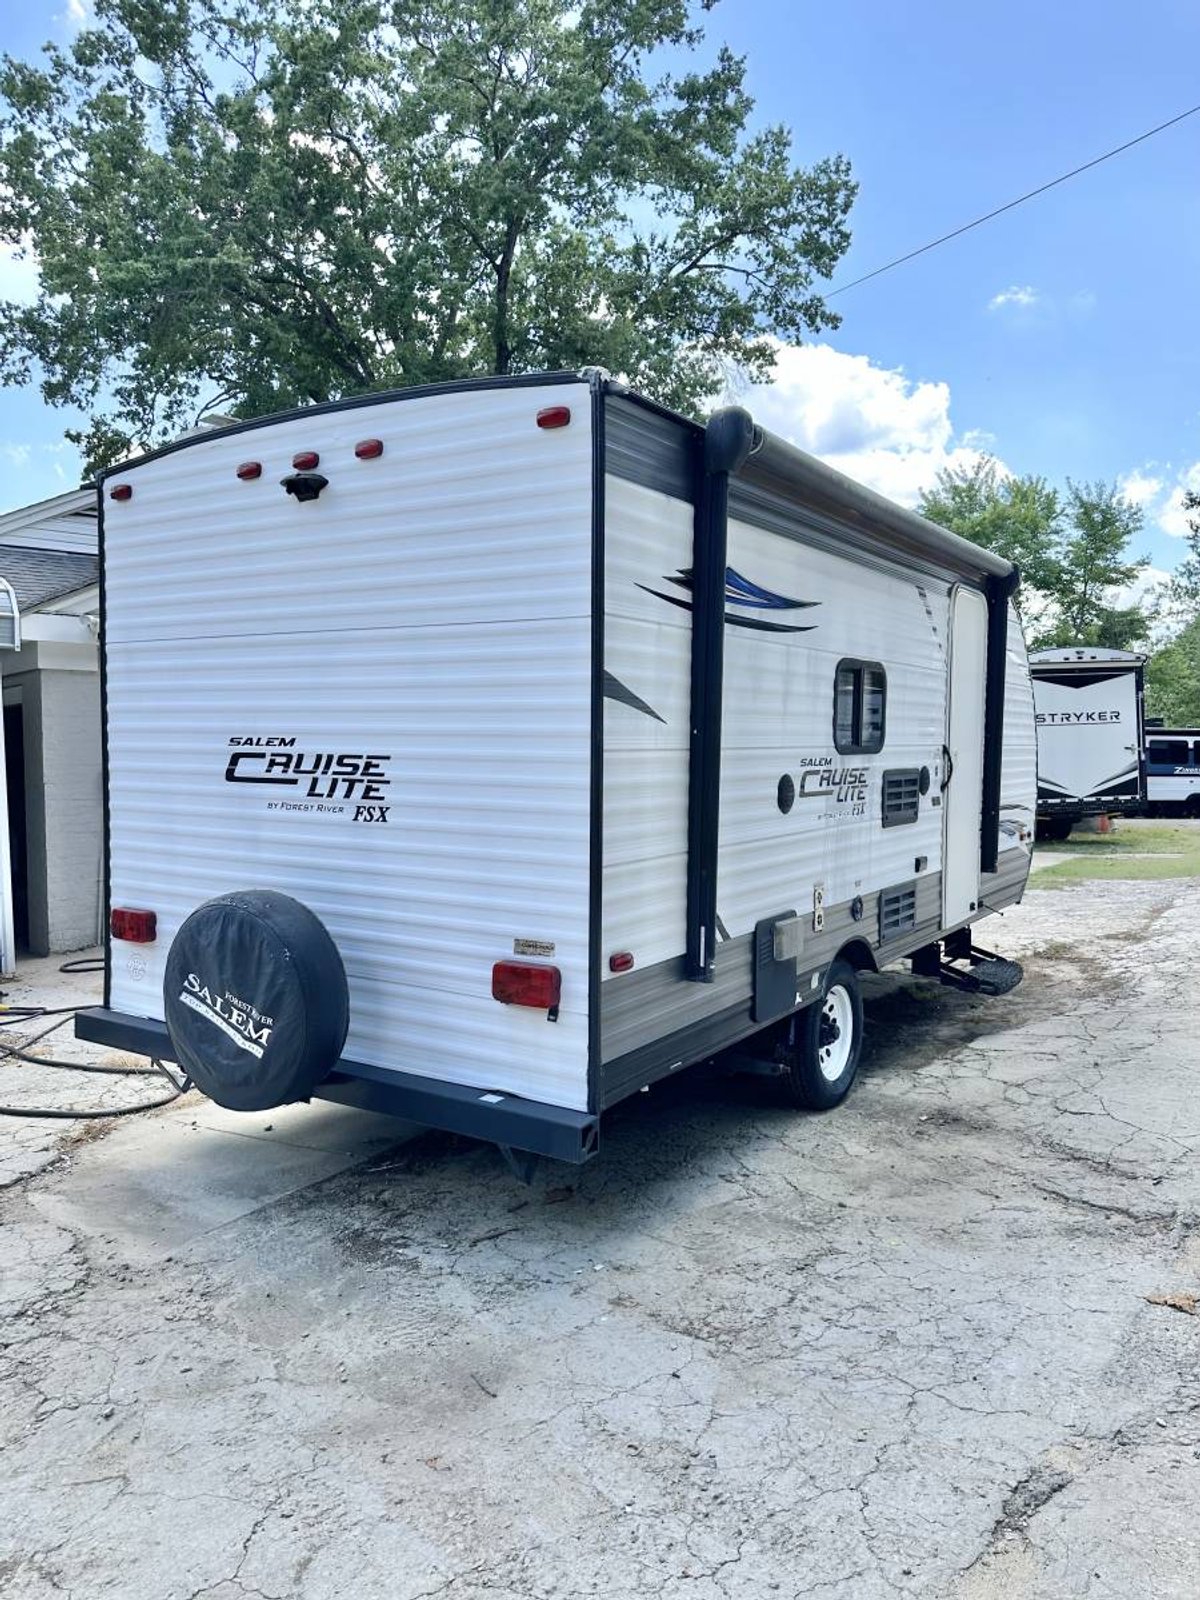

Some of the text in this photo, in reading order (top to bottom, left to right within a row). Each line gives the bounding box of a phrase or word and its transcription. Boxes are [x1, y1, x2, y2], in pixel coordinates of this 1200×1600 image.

[1036, 711, 1120, 723] STRYKER
[228, 737, 297, 747] SALEM
[225, 752, 391, 785] CRUISE
[800, 758, 833, 767] SALEM
[306, 777, 391, 801] LITE
[799, 767, 870, 798] CRUISE
[836, 784, 869, 803] LITE
[267, 802, 345, 814] BY FOREST RIVER
[352, 805, 391, 823] FSX
[183, 973, 273, 1047] SALEM
[225, 991, 251, 1012] FOREST
